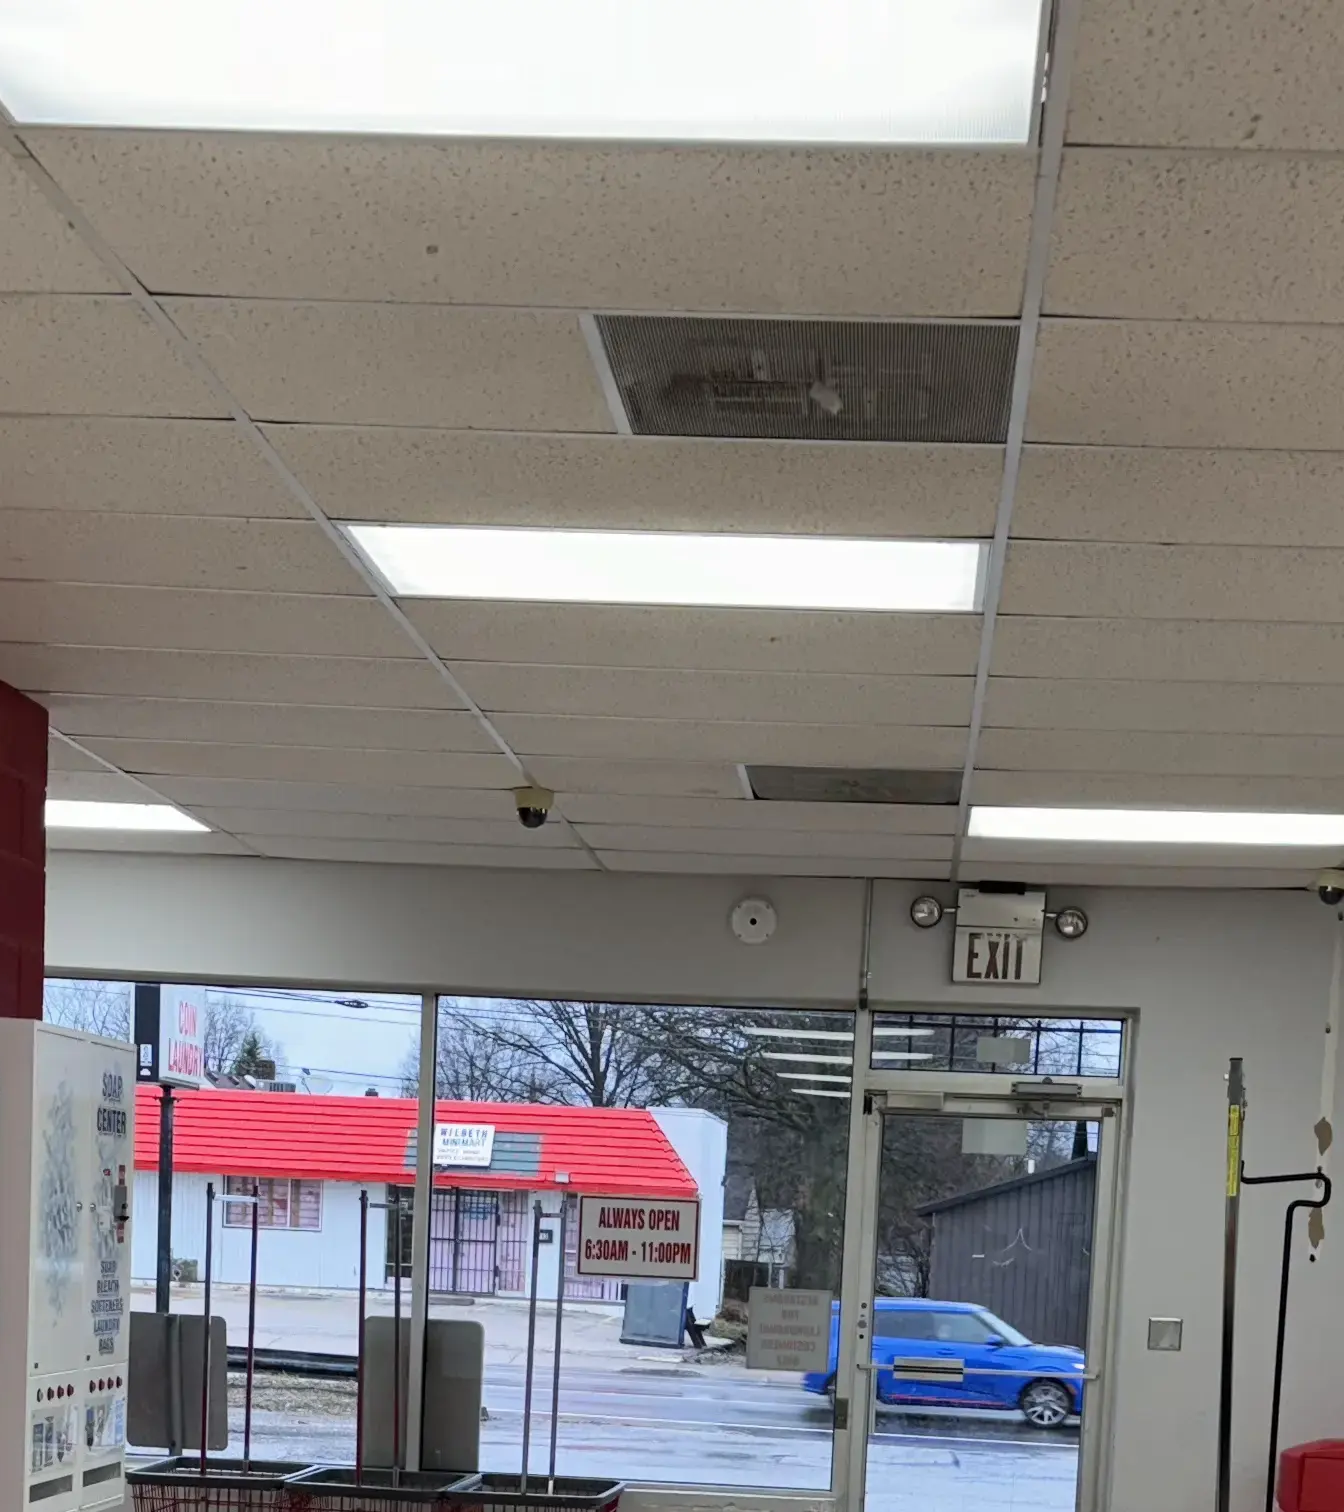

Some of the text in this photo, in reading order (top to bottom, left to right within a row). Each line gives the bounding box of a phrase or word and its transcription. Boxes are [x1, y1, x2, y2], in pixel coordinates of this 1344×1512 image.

[966, 931, 1028, 980] EXIT
[167, 1038, 205, 1077] LAUNDRY
[102, 1071, 124, 1098] SOAP
[97, 1106, 126, 1134] CENTER
[440, 1127, 488, 1138] WILBETH
[598, 1207, 680, 1231] ALWAYS OPEN
[585, 1239, 629, 1261] 6:30AM
[641, 1241, 691, 1264] 11:00PM
